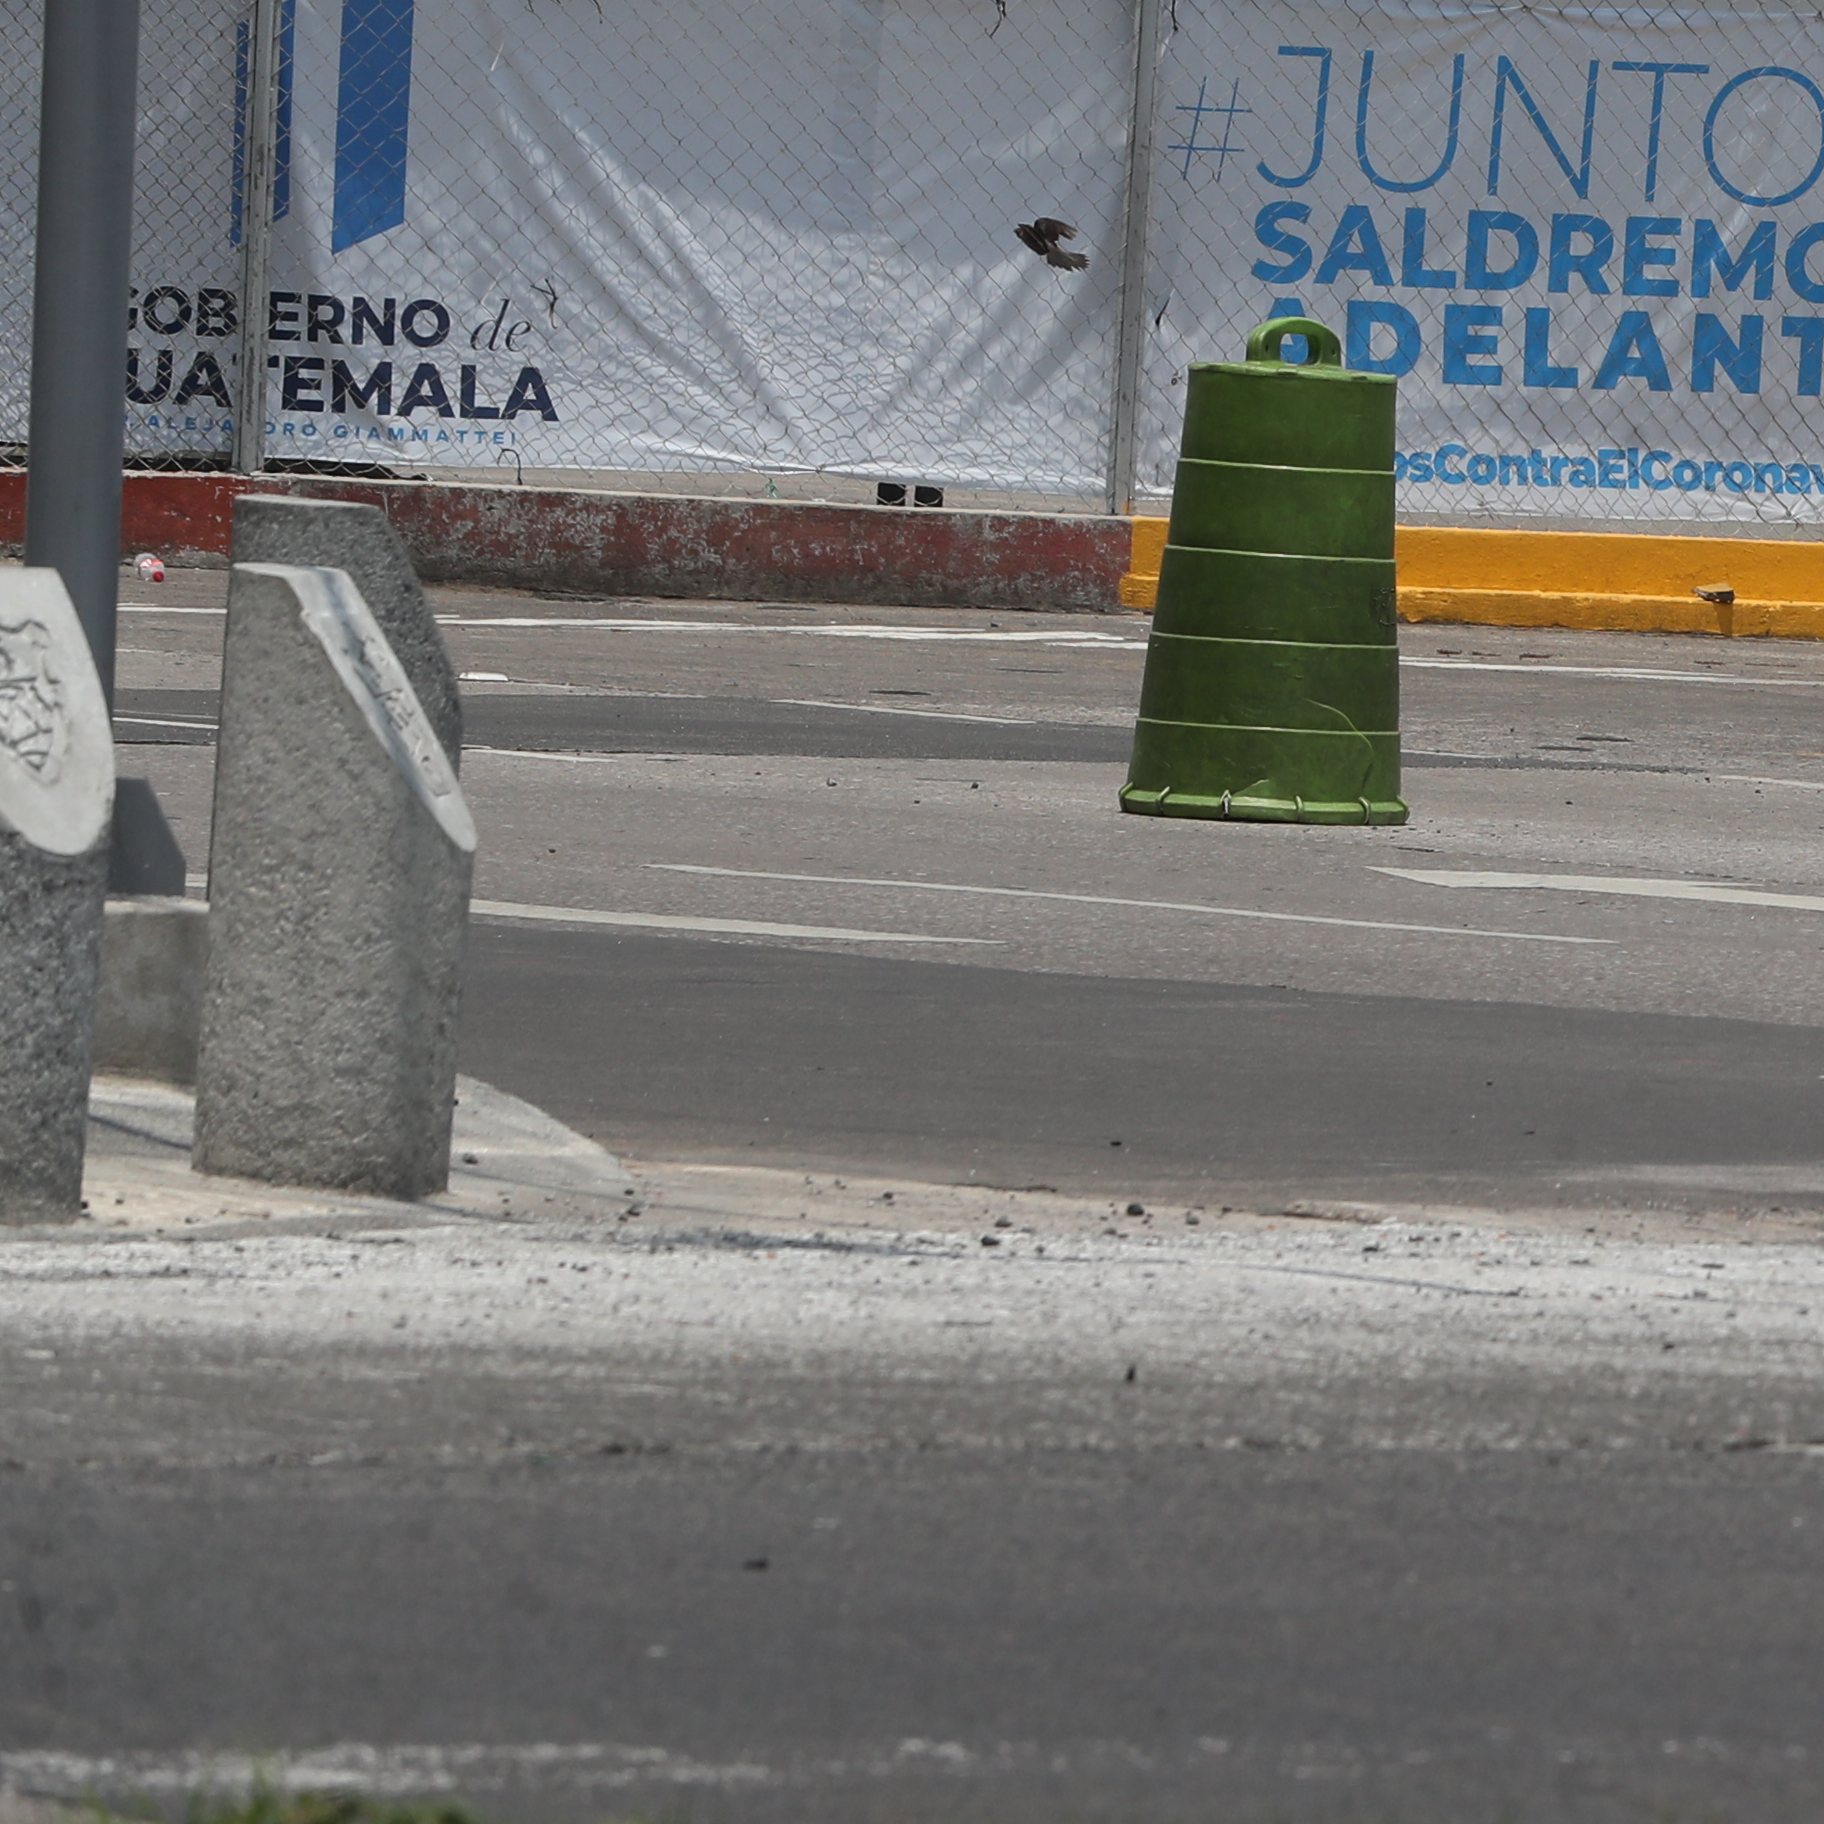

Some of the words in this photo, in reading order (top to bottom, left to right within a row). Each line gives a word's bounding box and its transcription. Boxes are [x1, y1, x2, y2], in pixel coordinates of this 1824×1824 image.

[128, 285, 452, 348] OBERNO
[469, 297, 532, 353] de
[125, 348, 560, 421] UAEMALA
[147, 414, 318, 437] ALEJADRO
[333, 423, 518, 446] GIAMMATTEI
